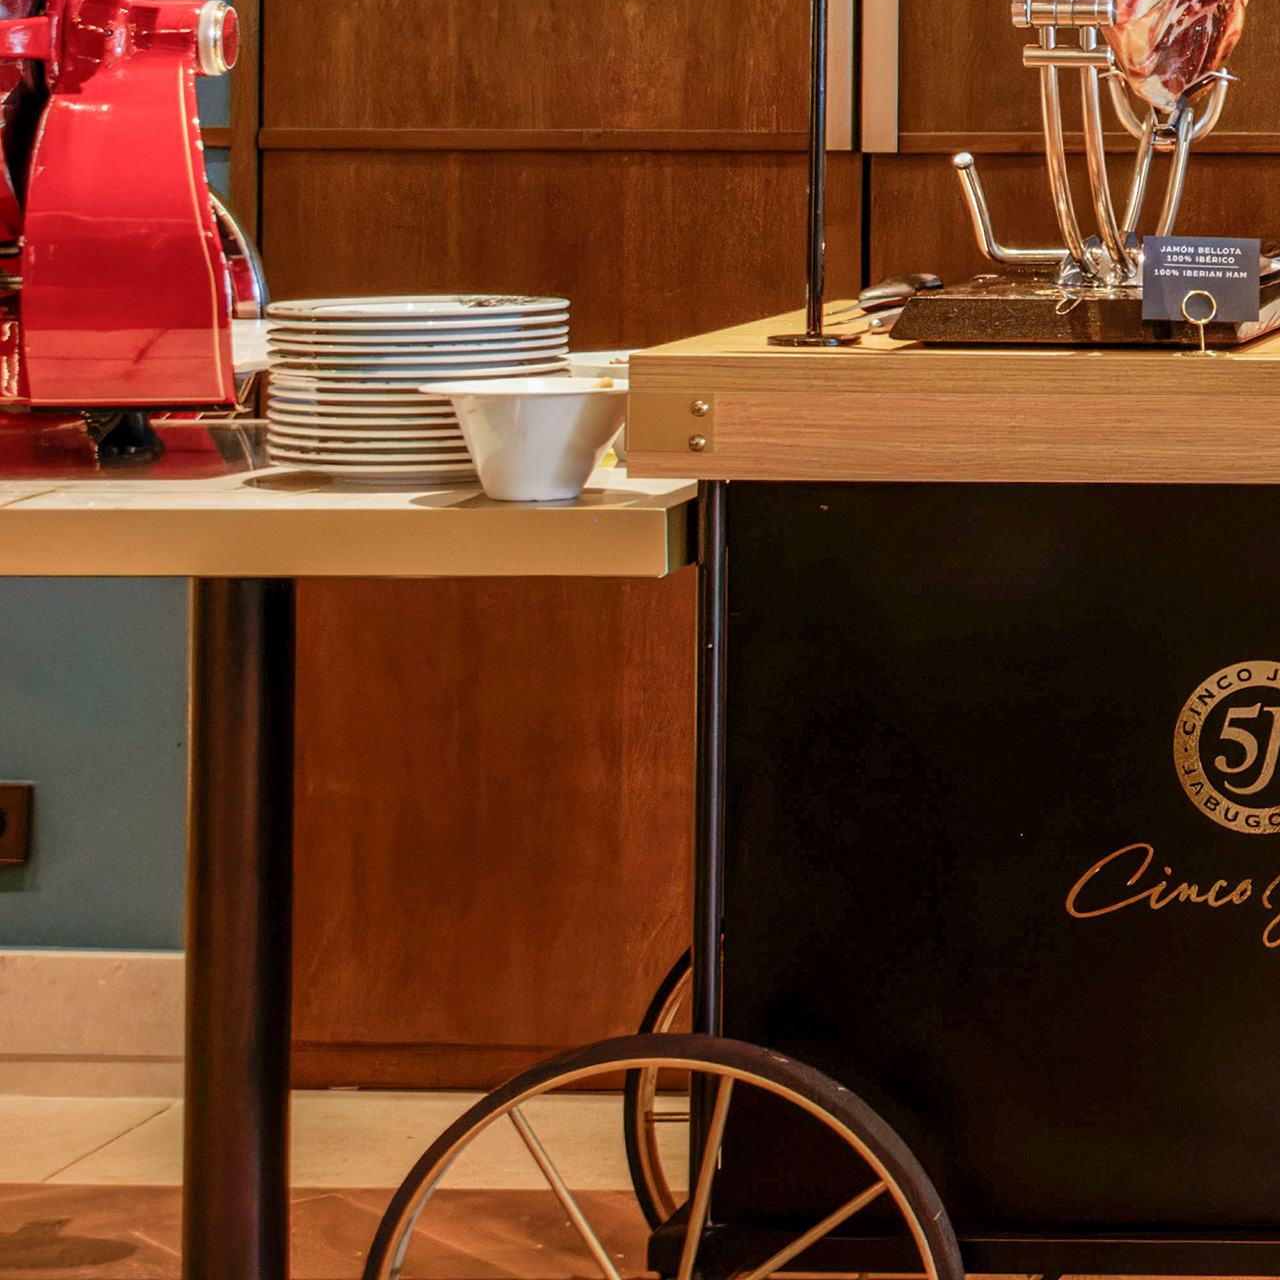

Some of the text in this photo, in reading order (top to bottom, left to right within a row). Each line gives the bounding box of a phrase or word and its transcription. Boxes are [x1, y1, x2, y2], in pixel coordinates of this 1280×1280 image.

[1160, 244, 1242, 255] JAMÓN BELLOTA
[1166, 254, 1236, 264] 100% IBÉRICO
[1154, 268, 1248, 279] 100% IBERIAN HAM
[1183, 668, 1252, 736] CINCO
[1066, 842, 1253, 919] Cinco
